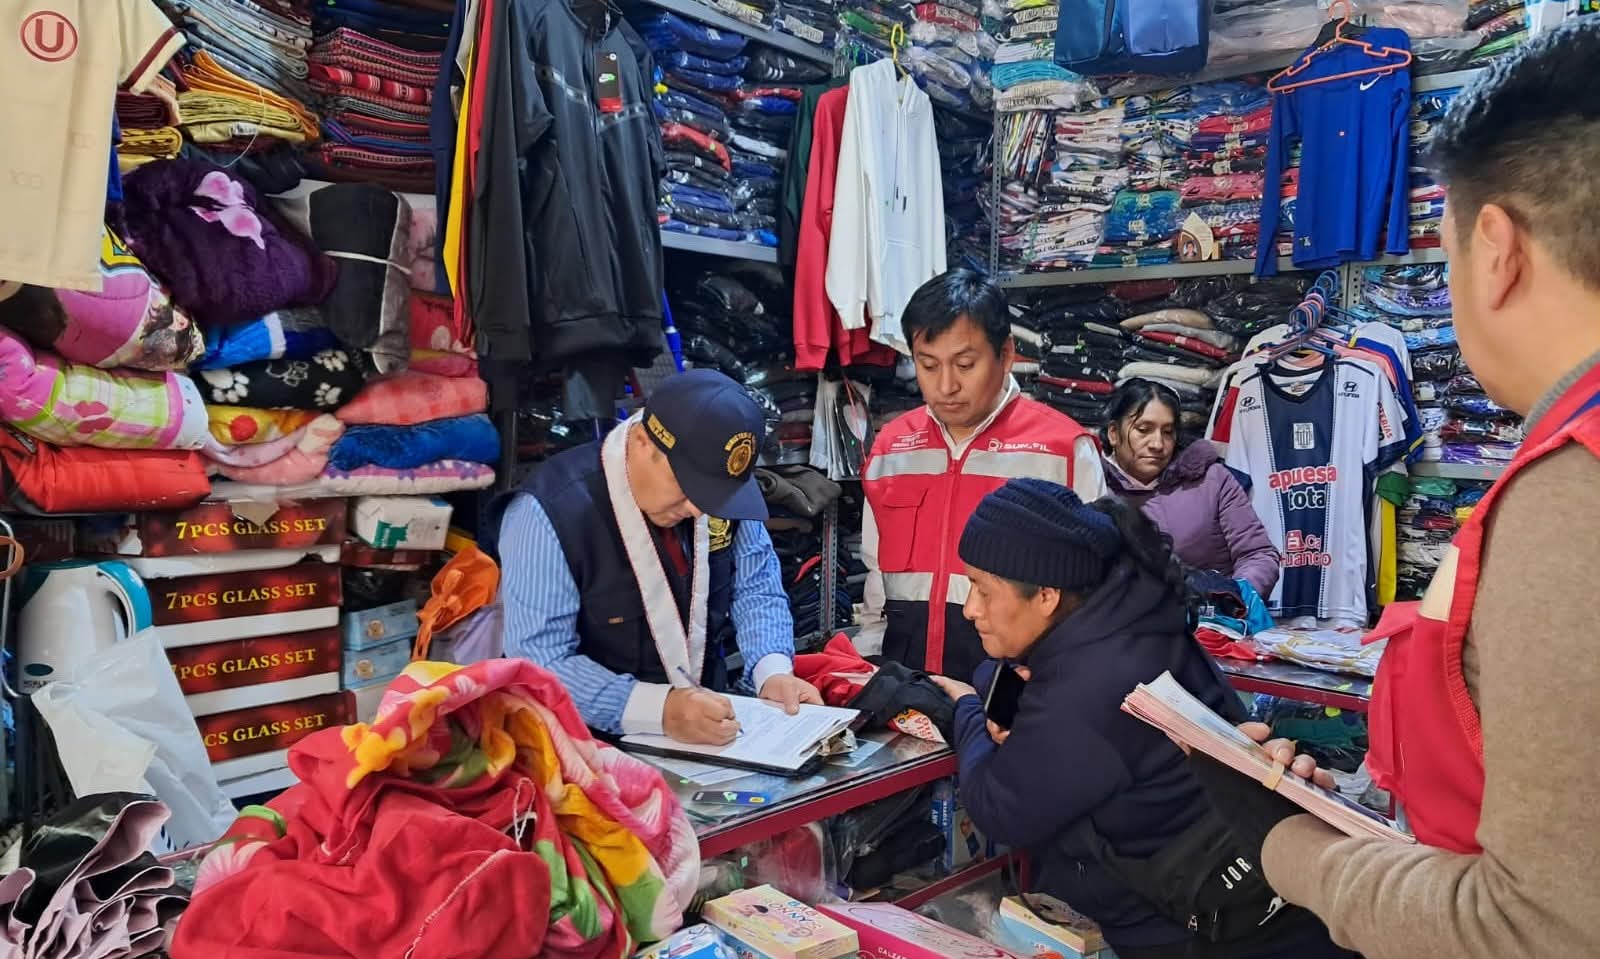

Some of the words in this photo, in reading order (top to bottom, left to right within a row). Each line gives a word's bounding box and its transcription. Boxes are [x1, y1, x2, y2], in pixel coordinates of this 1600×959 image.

[35, 19, 65, 53] U
[1269, 465, 1337, 493] apuesa
[233, 521, 289, 536] GLASS
[294, 518, 327, 533] SET
[222, 587, 281, 604] GLASS
[285, 583, 318, 597] SET
[222, 655, 280, 673] GLASS
[284, 649, 316, 664] SET
[204, 731, 229, 747] CS
[232, 720, 291, 742] GLASS
[294, 713, 325, 731] SET
[1221, 857, 1252, 889] JOR
